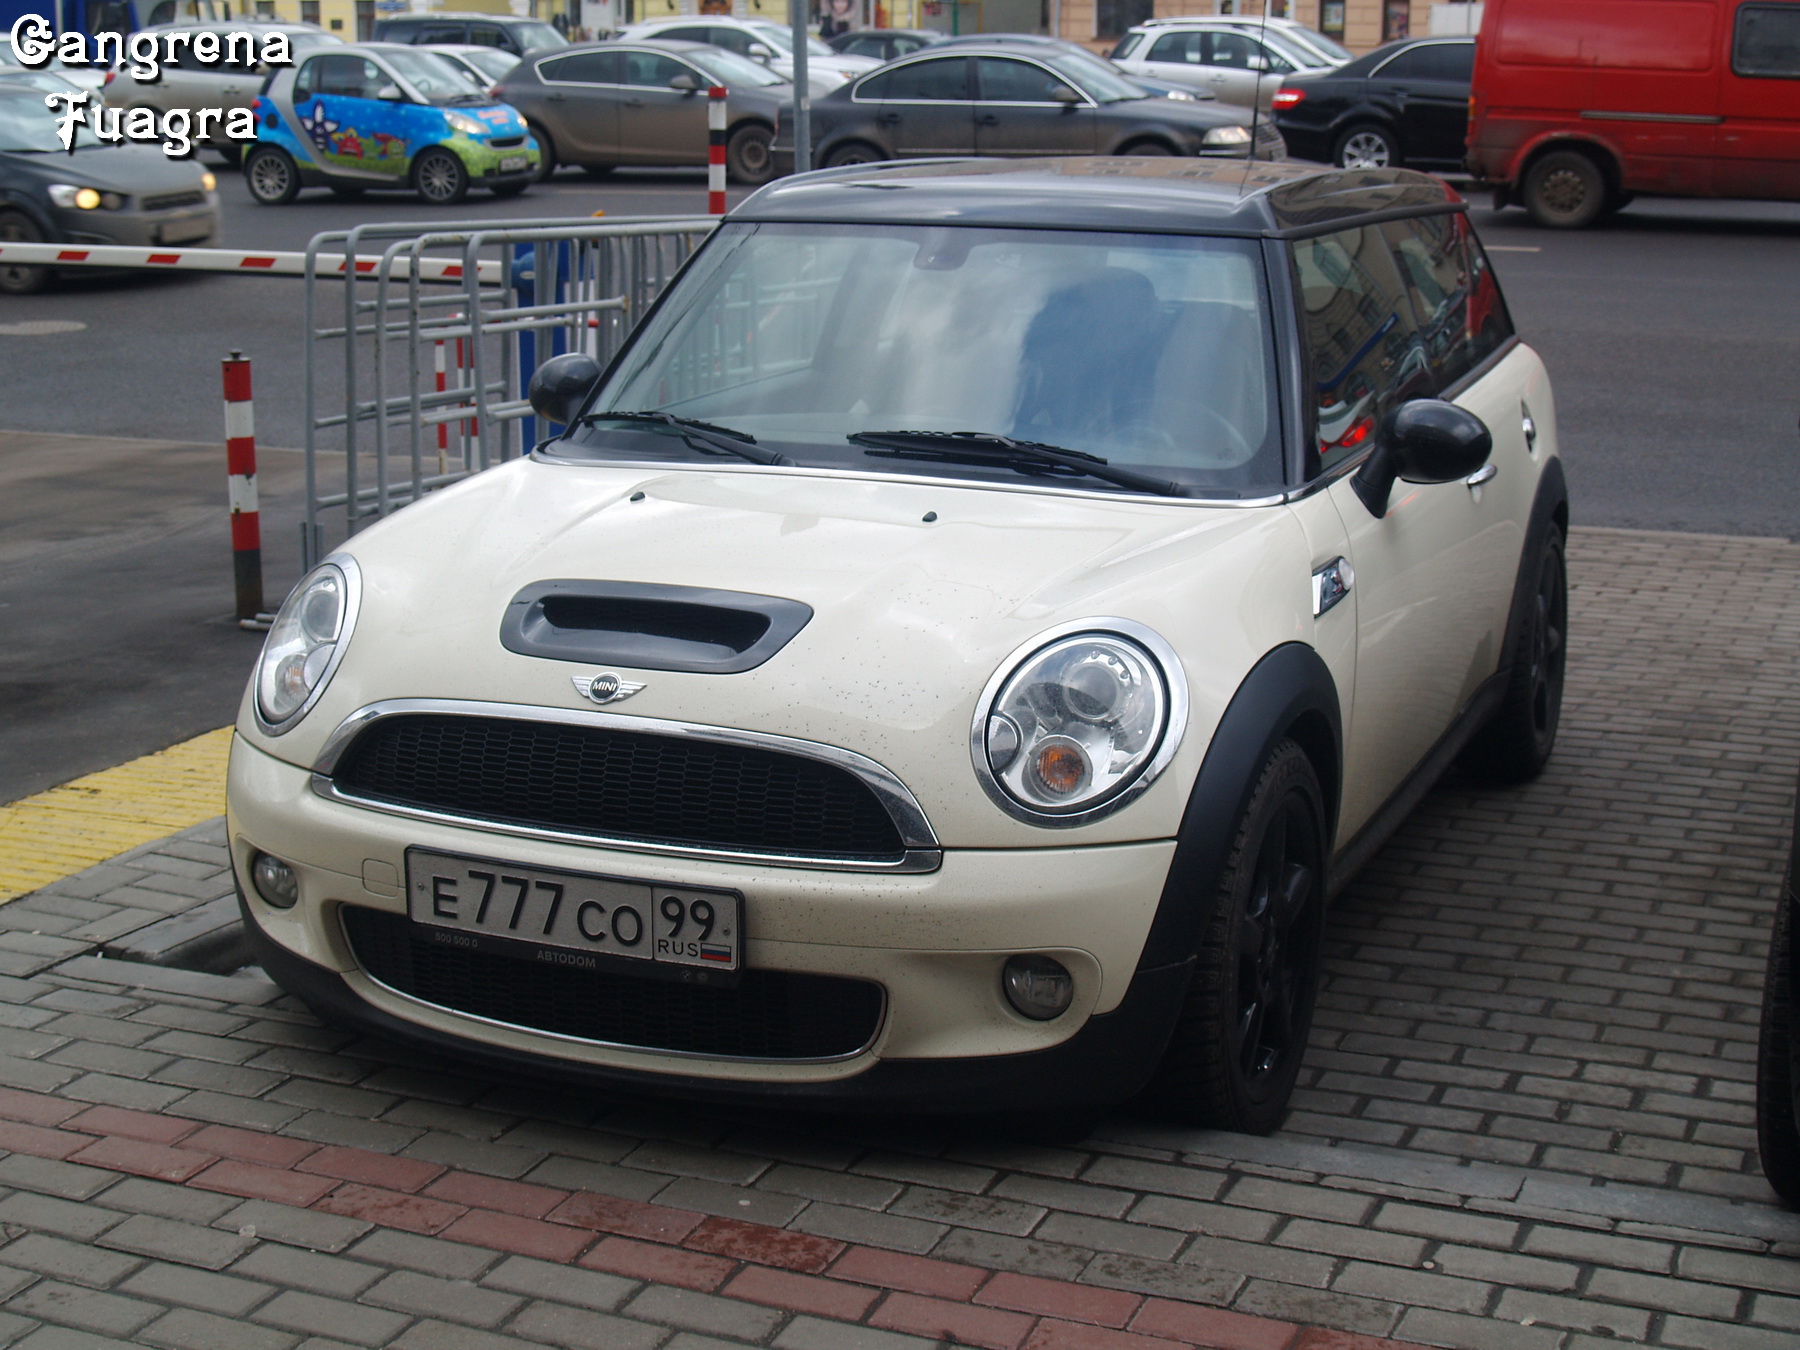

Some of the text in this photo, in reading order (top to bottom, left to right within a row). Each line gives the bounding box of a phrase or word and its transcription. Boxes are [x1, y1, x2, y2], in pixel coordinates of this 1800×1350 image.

[592, 681, 618, 692] MINI
[660, 895, 715, 942] 99
[657, 939, 699, 957] RUS
